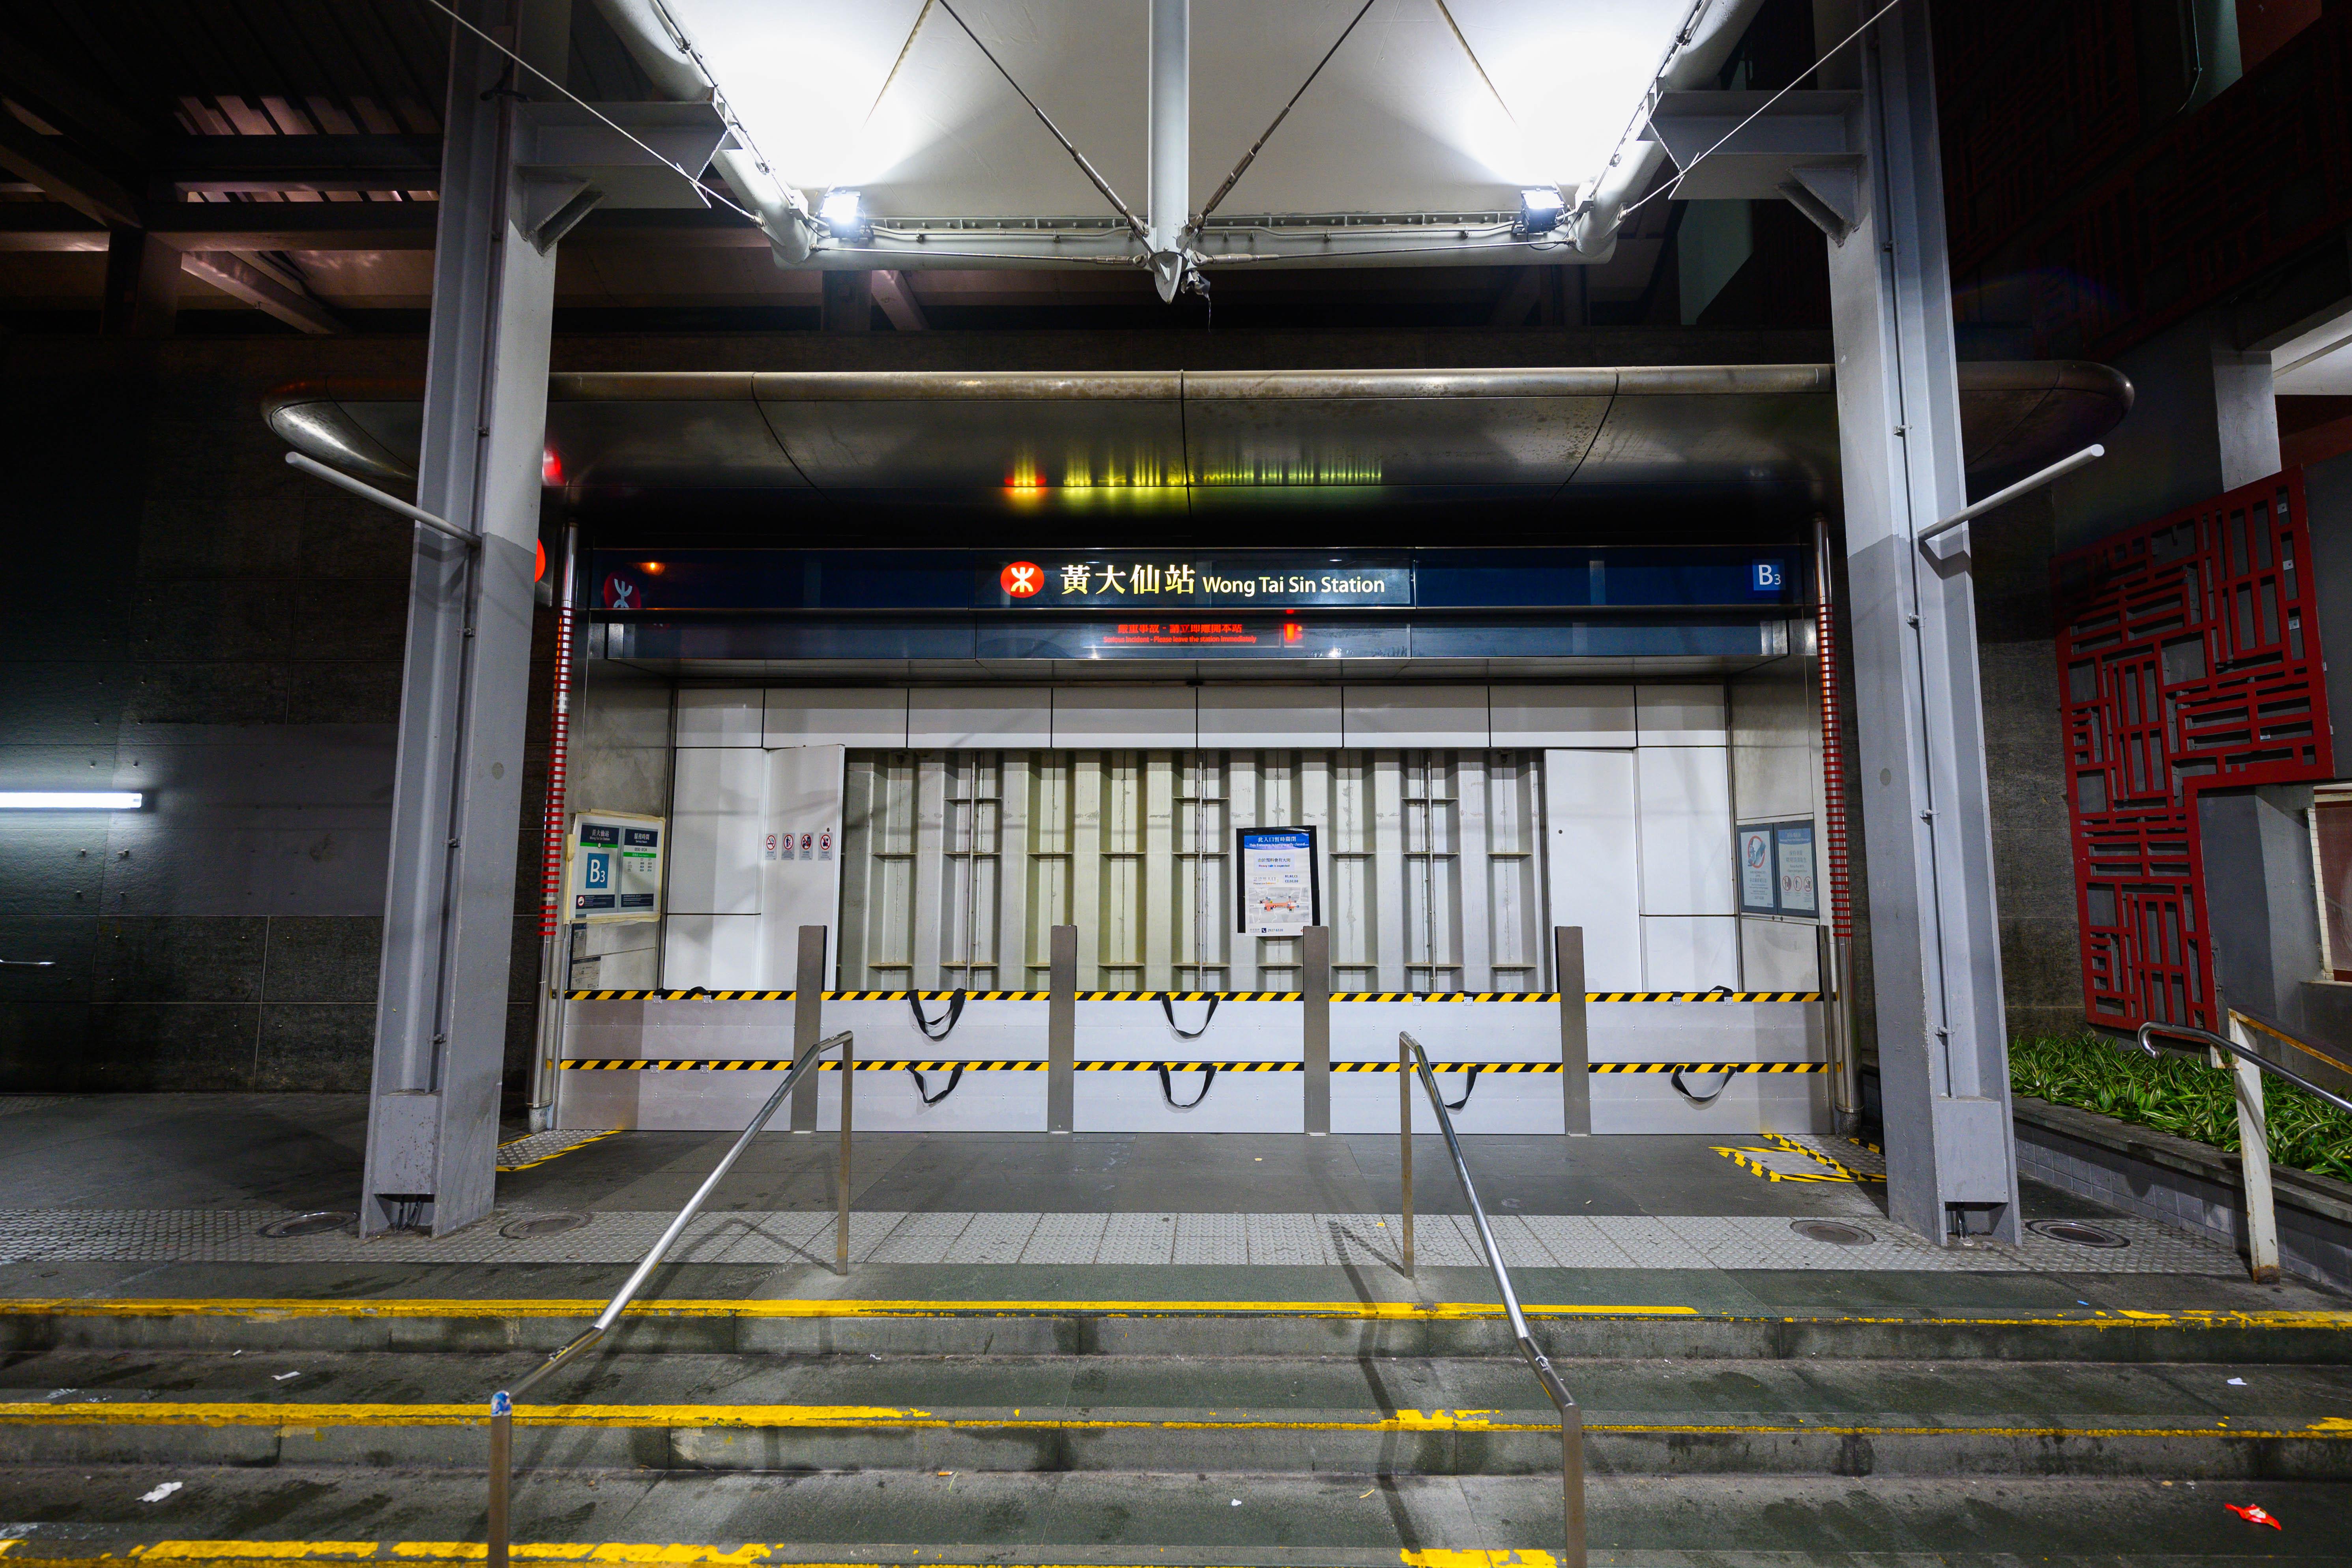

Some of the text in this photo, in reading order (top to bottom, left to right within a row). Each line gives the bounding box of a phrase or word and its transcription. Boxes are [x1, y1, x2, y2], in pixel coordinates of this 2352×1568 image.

[1060, 565, 1196, 594] 黃大仙站
[1758, 564, 1781, 585] B3
[1203, 576, 1385, 597] Wong Tai Sin Station
[590, 859, 605, 882] B3
